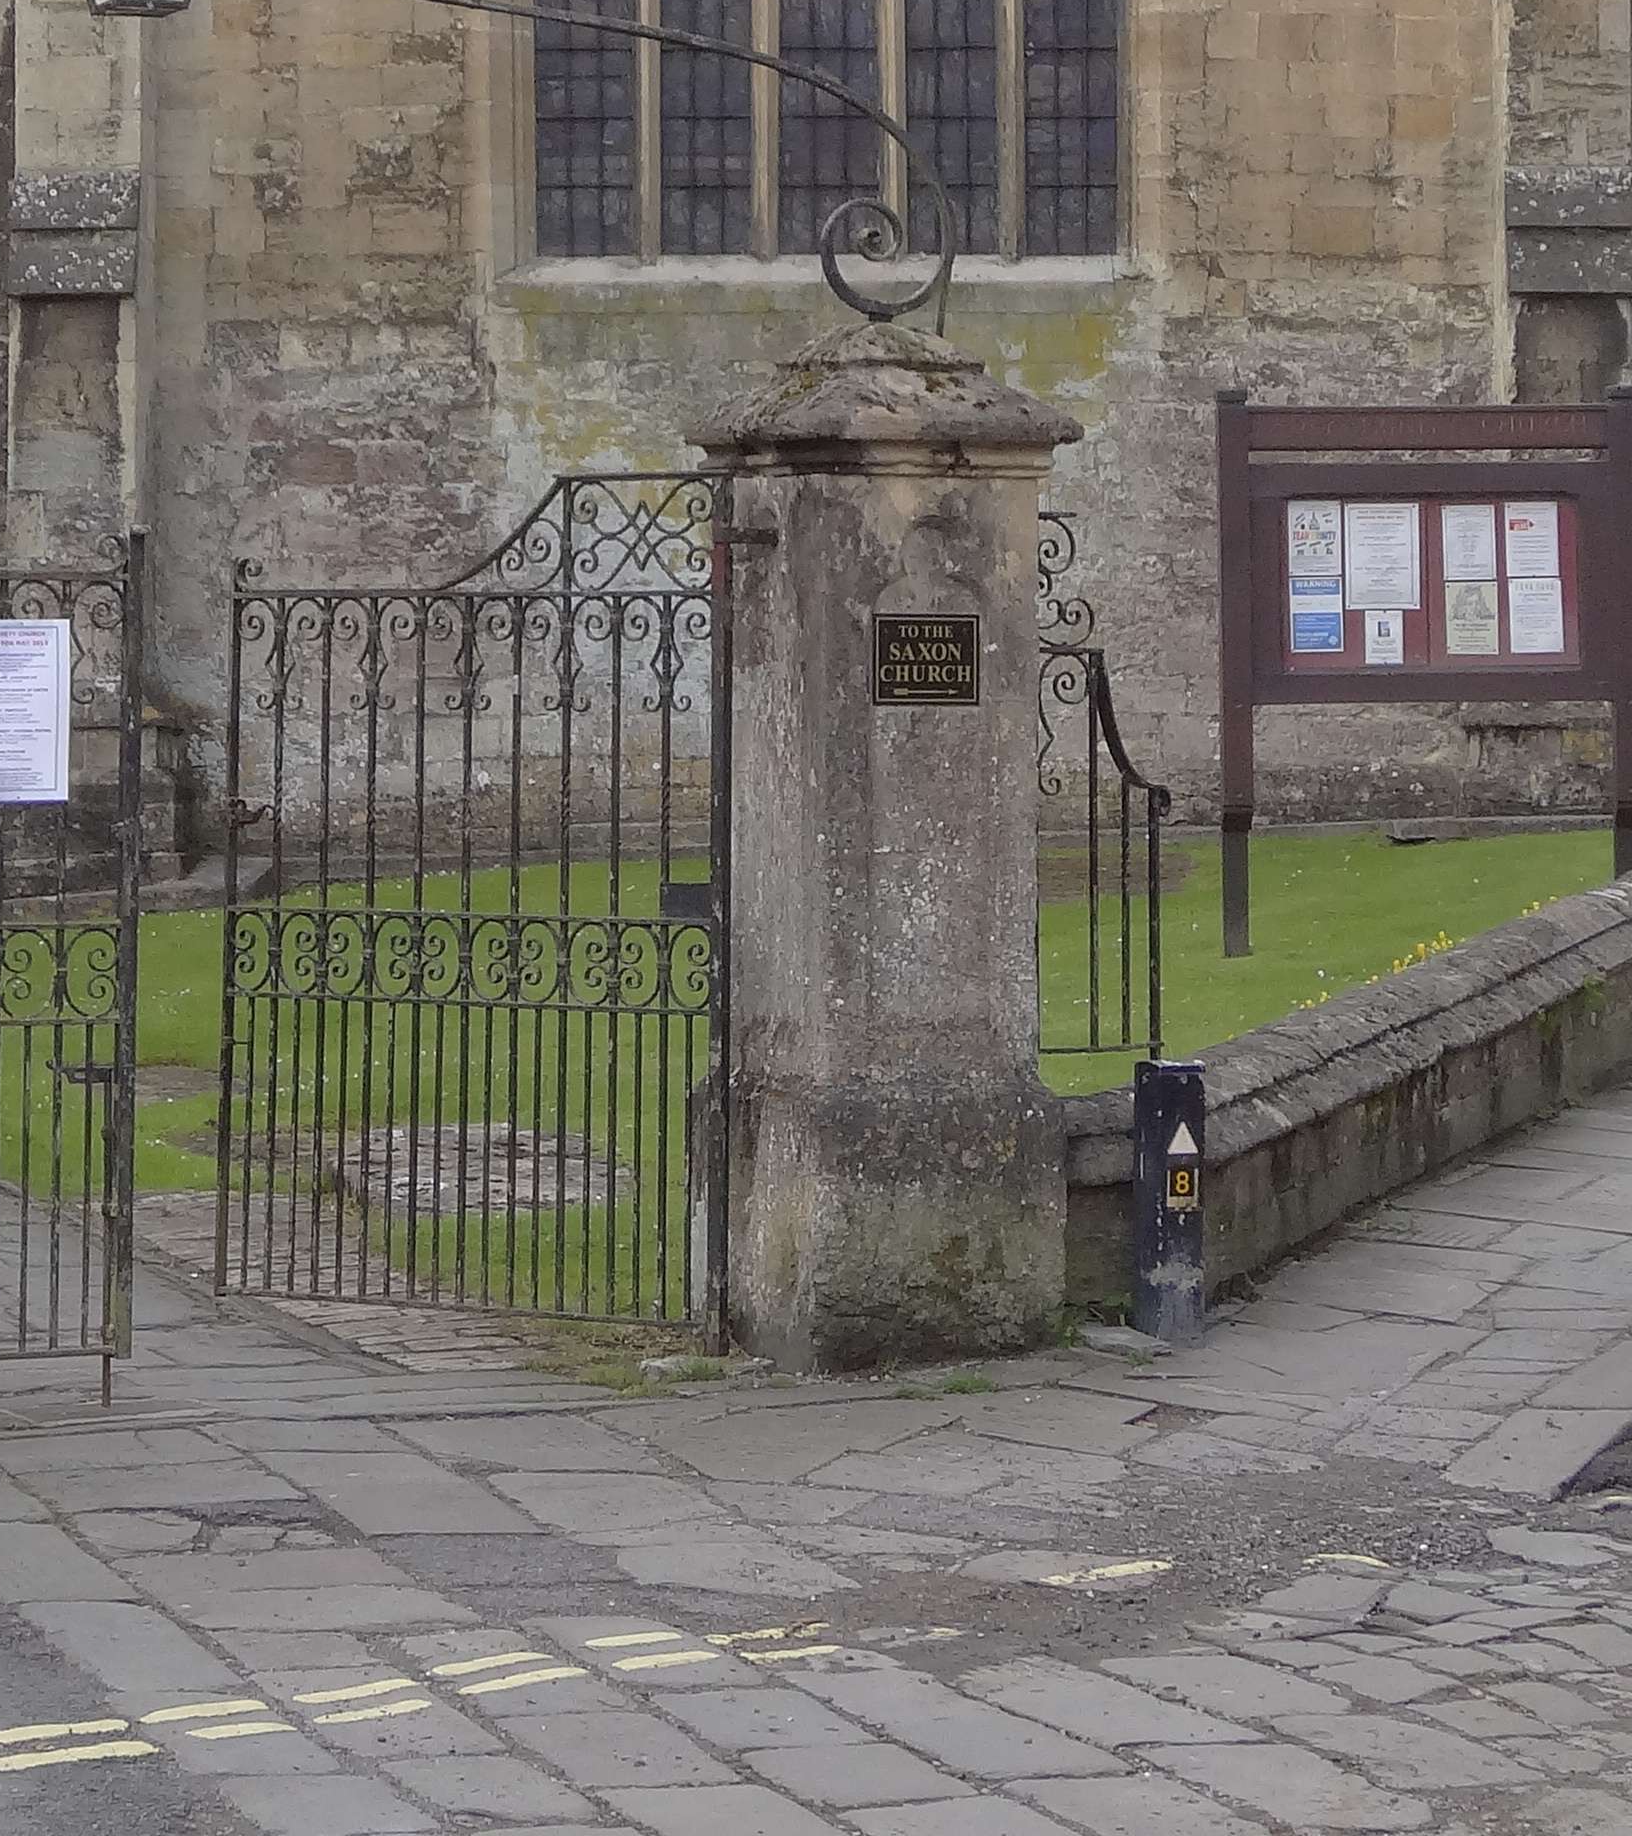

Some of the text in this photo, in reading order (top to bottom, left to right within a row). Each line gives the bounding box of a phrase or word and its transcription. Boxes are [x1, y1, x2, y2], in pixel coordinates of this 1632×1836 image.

[1295, 580, 1337, 589] WARNING
[898, 625, 953, 638] TO THE
[889, 642, 962, 661] SAXON
[880, 665, 971, 683] CHURCH
[1175, 1171, 1190, 1194] 8
